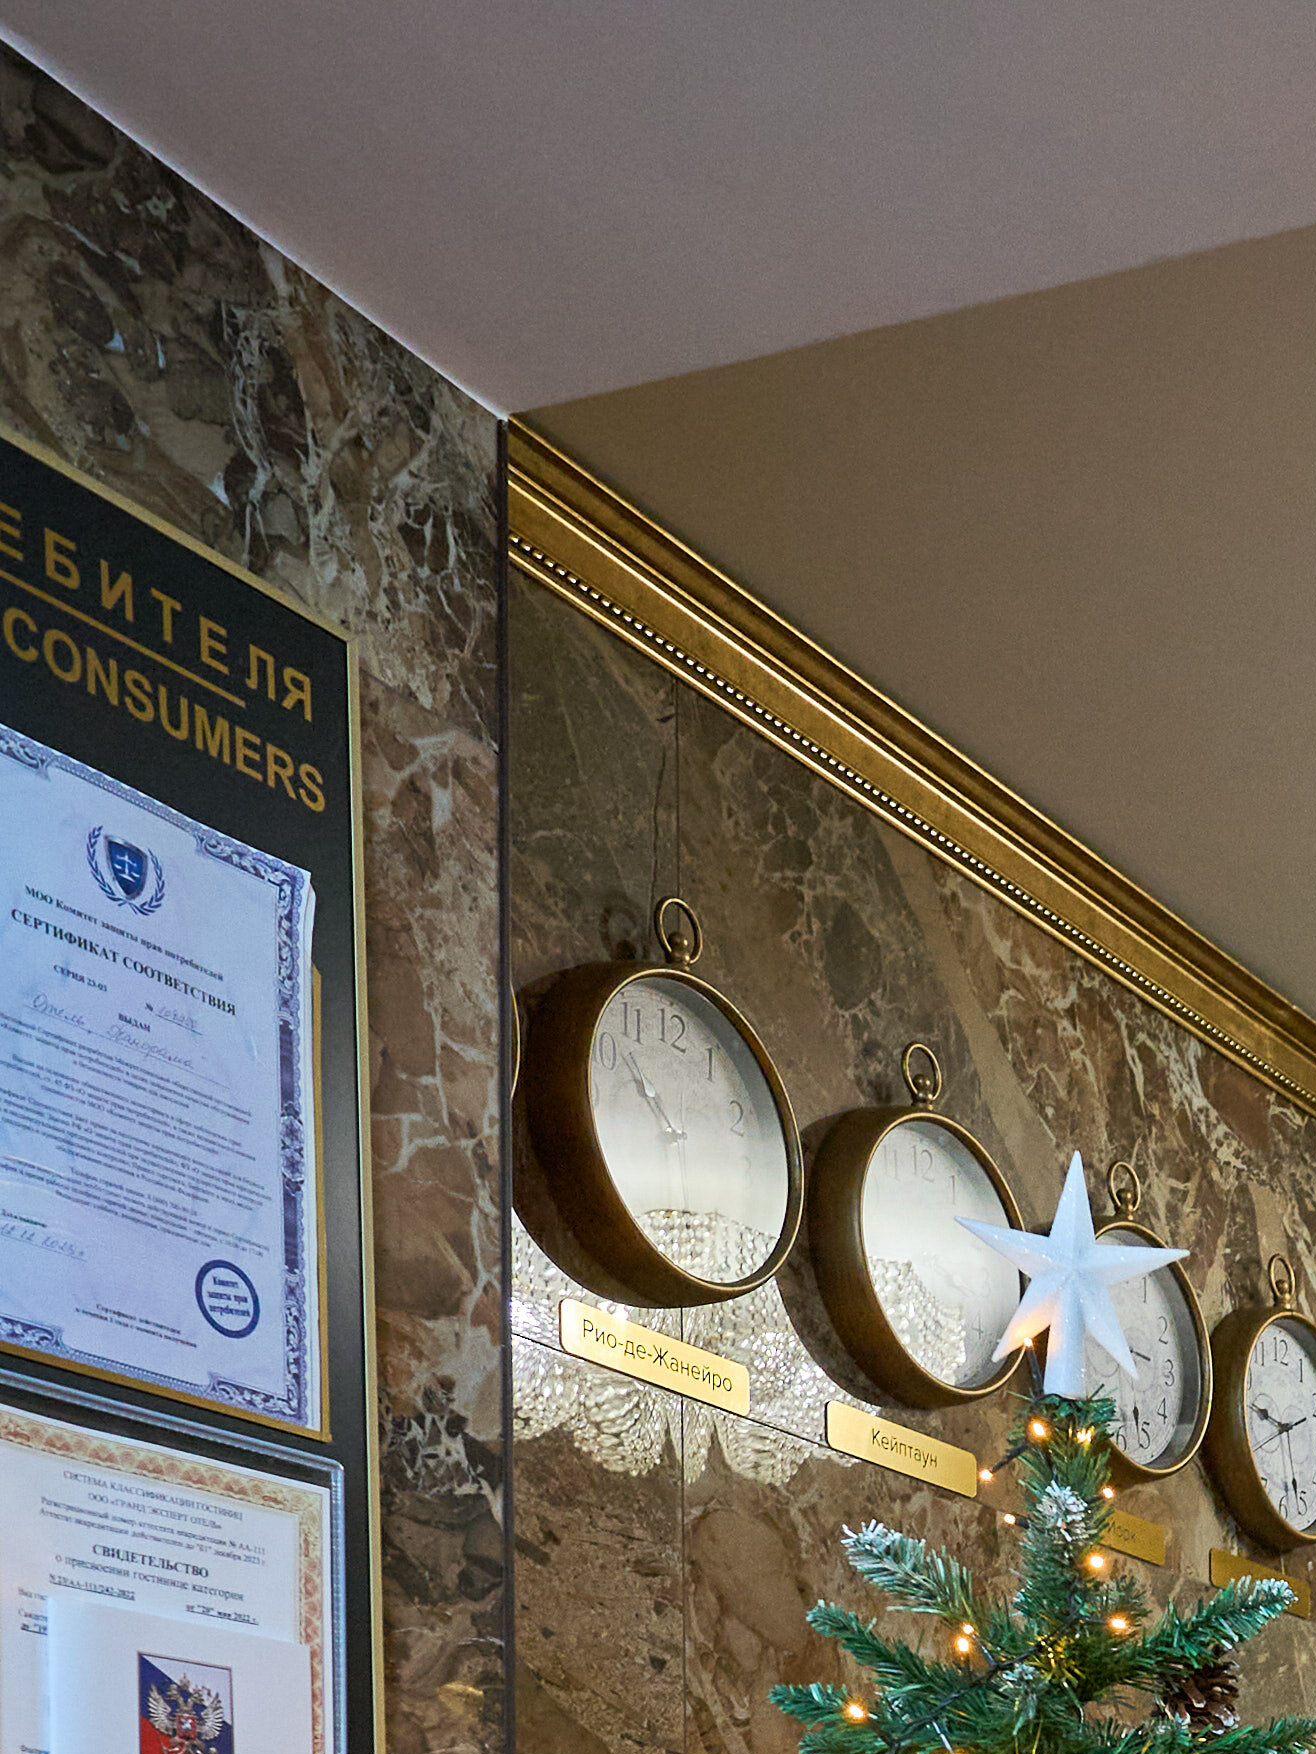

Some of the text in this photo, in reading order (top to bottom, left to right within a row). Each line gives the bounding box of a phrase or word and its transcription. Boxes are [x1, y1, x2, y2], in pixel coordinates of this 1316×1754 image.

[3, 607, 326, 812] CONSUMERS
[10, 906, 236, 1017] СЕРТИФИКАТ СООТВЕТСТВИЯ
[620, 1001, 643, 1045] 11
[658, 1007, 687, 1054] 12
[729, 1100, 744, 1137] 2
[1158, 1316, 1168, 1345] 2
[582, 1319, 733, 1392] Рио-де-Жанейро
[1274, 1337, 1288, 1366] 12
[1164, 1359, 1175, 1387] 3
[1157, 1397, 1168, 1424] 4
[871, 1428, 938, 1469] Кейптаун
[1139, 1421, 1150, 1450] 5
[1279, 1494, 1288, 1520] 6
[93, 1544, 208, 1578] СВИДЕТЕЛЬСТВО
